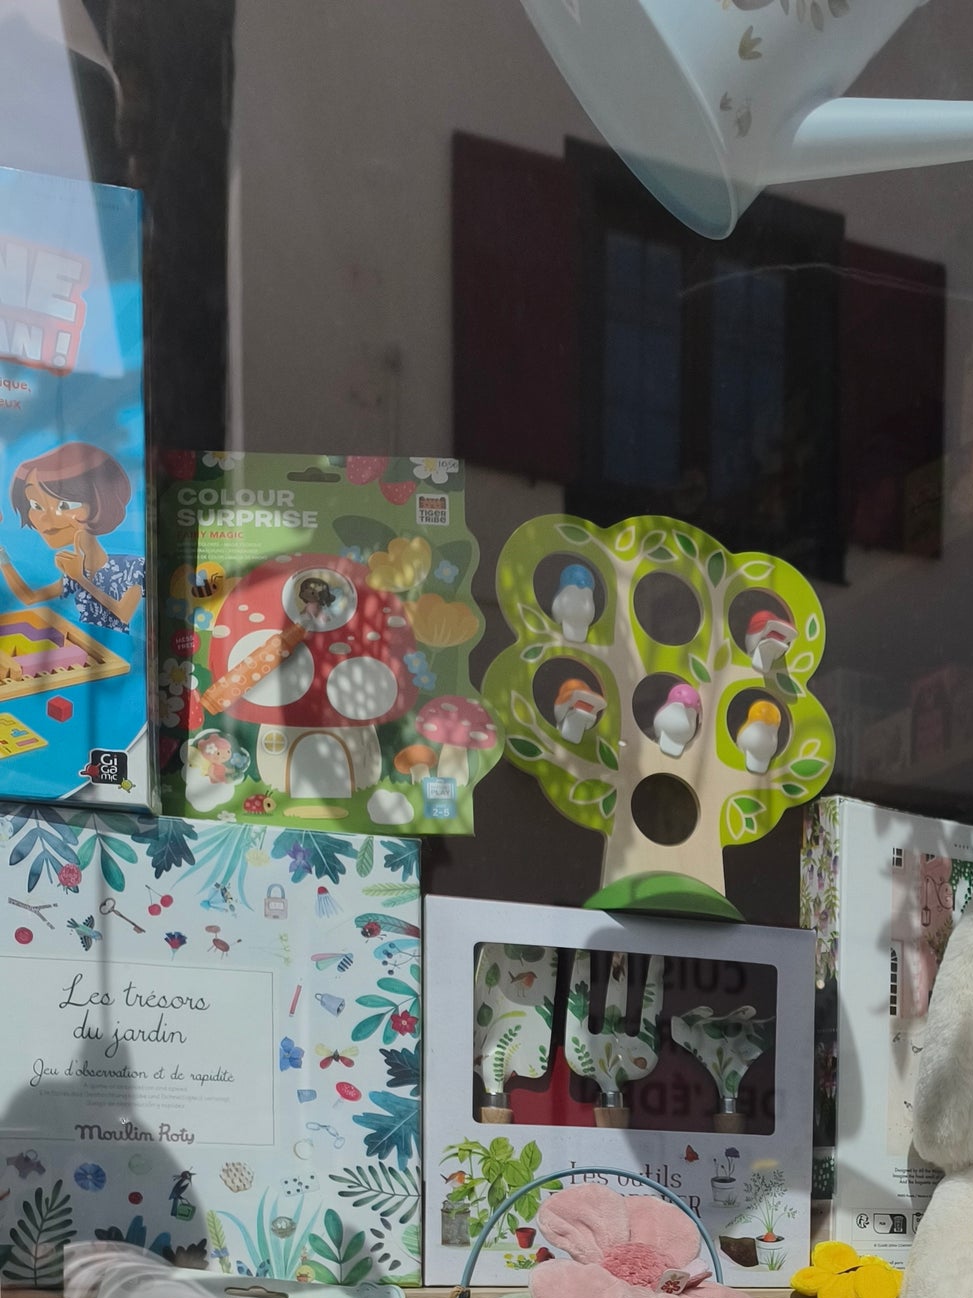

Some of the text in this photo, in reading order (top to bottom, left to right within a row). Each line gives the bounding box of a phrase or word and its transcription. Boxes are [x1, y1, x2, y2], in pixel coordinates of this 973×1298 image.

[177, 488, 295, 507] COLOUR
[176, 509, 318, 528] SURPRISE
[209, 531, 244, 539] MAGIC
[59, 973, 210, 1011] Les trésors
[73, 1009, 187, 1058] du jardin
[30, 1058, 60, 1087] Jeu
[64, 1060, 148, 1080] d'observation
[153, 1066, 166, 1080] et
[170, 1064, 185, 1081] de
[74, 1121, 196, 1145] Moulin Roty
